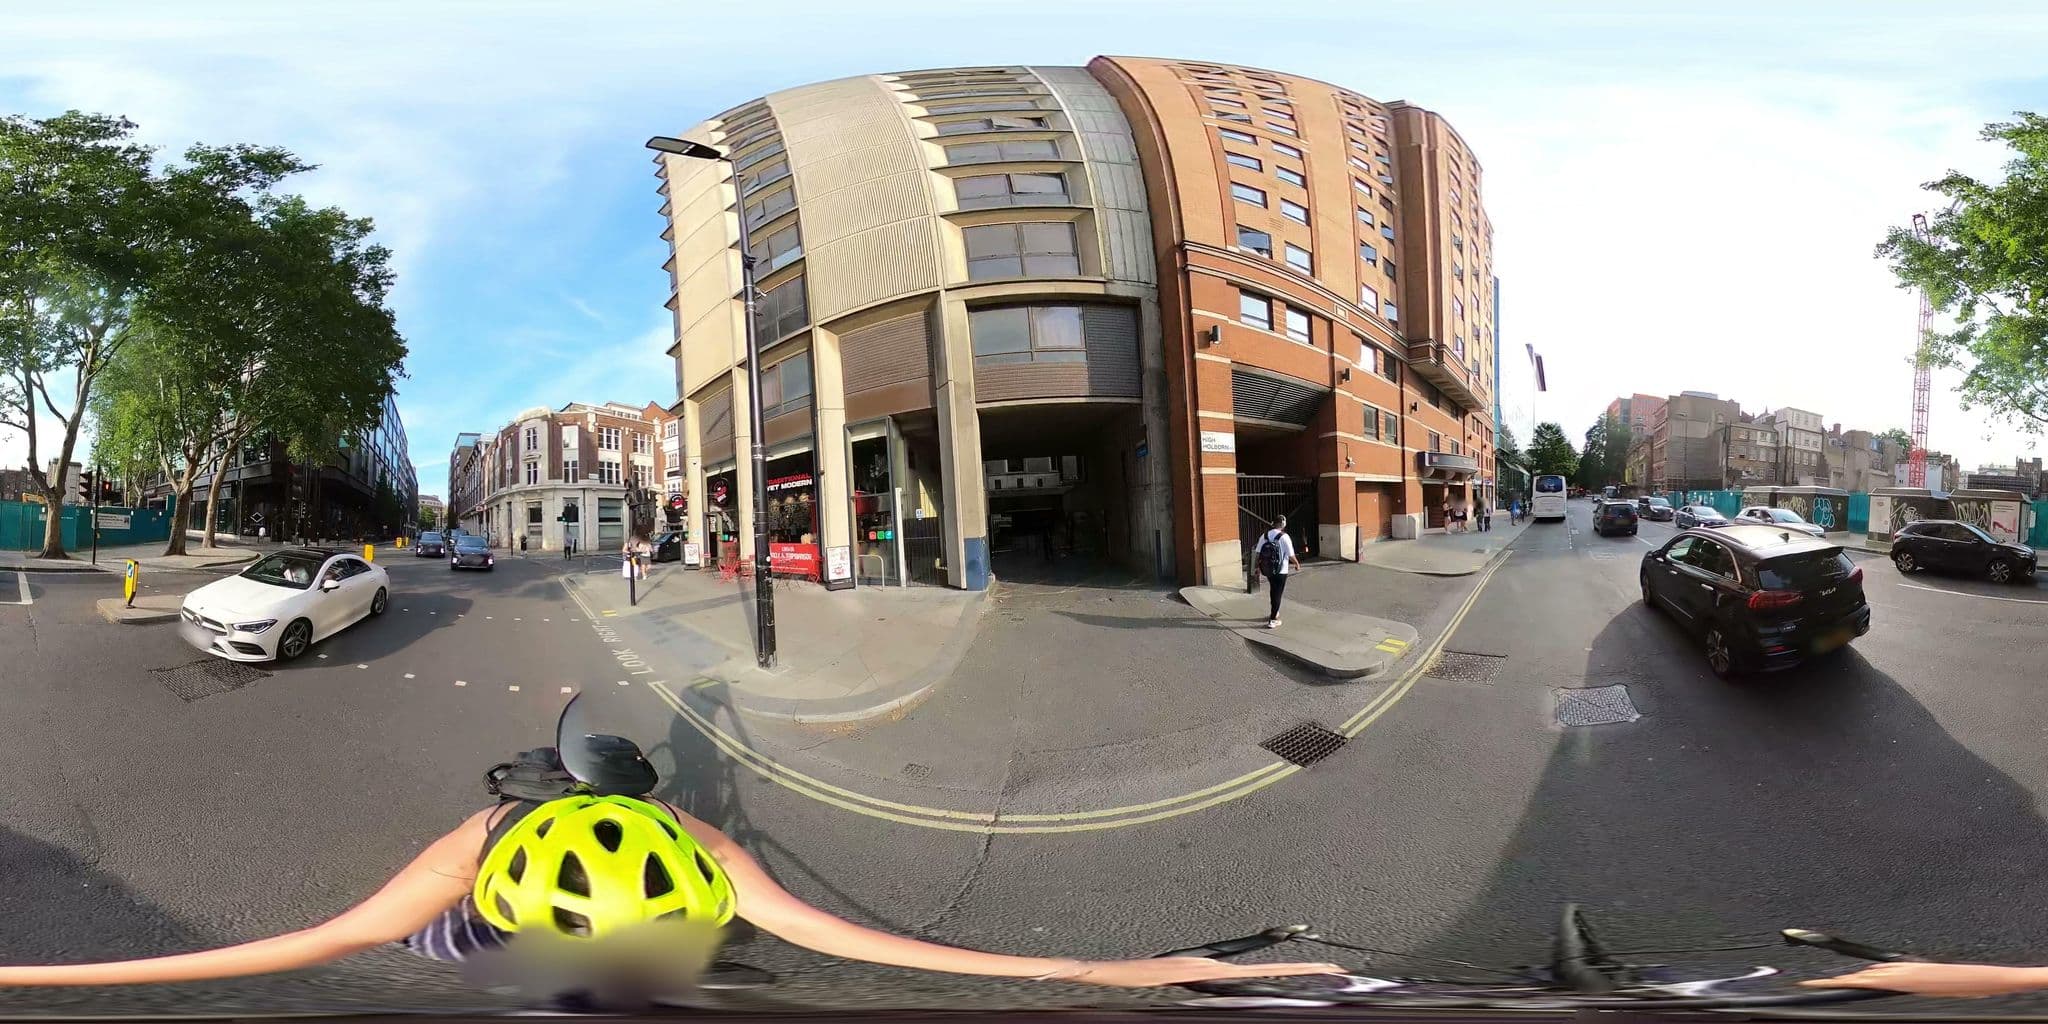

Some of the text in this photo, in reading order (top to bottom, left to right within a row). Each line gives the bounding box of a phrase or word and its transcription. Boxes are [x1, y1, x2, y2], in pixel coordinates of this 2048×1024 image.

[768, 473, 812, 485] RADITIONAL
[781, 479, 812, 489] MODERN
[592, 620, 655, 674] LOOK RIGHT
